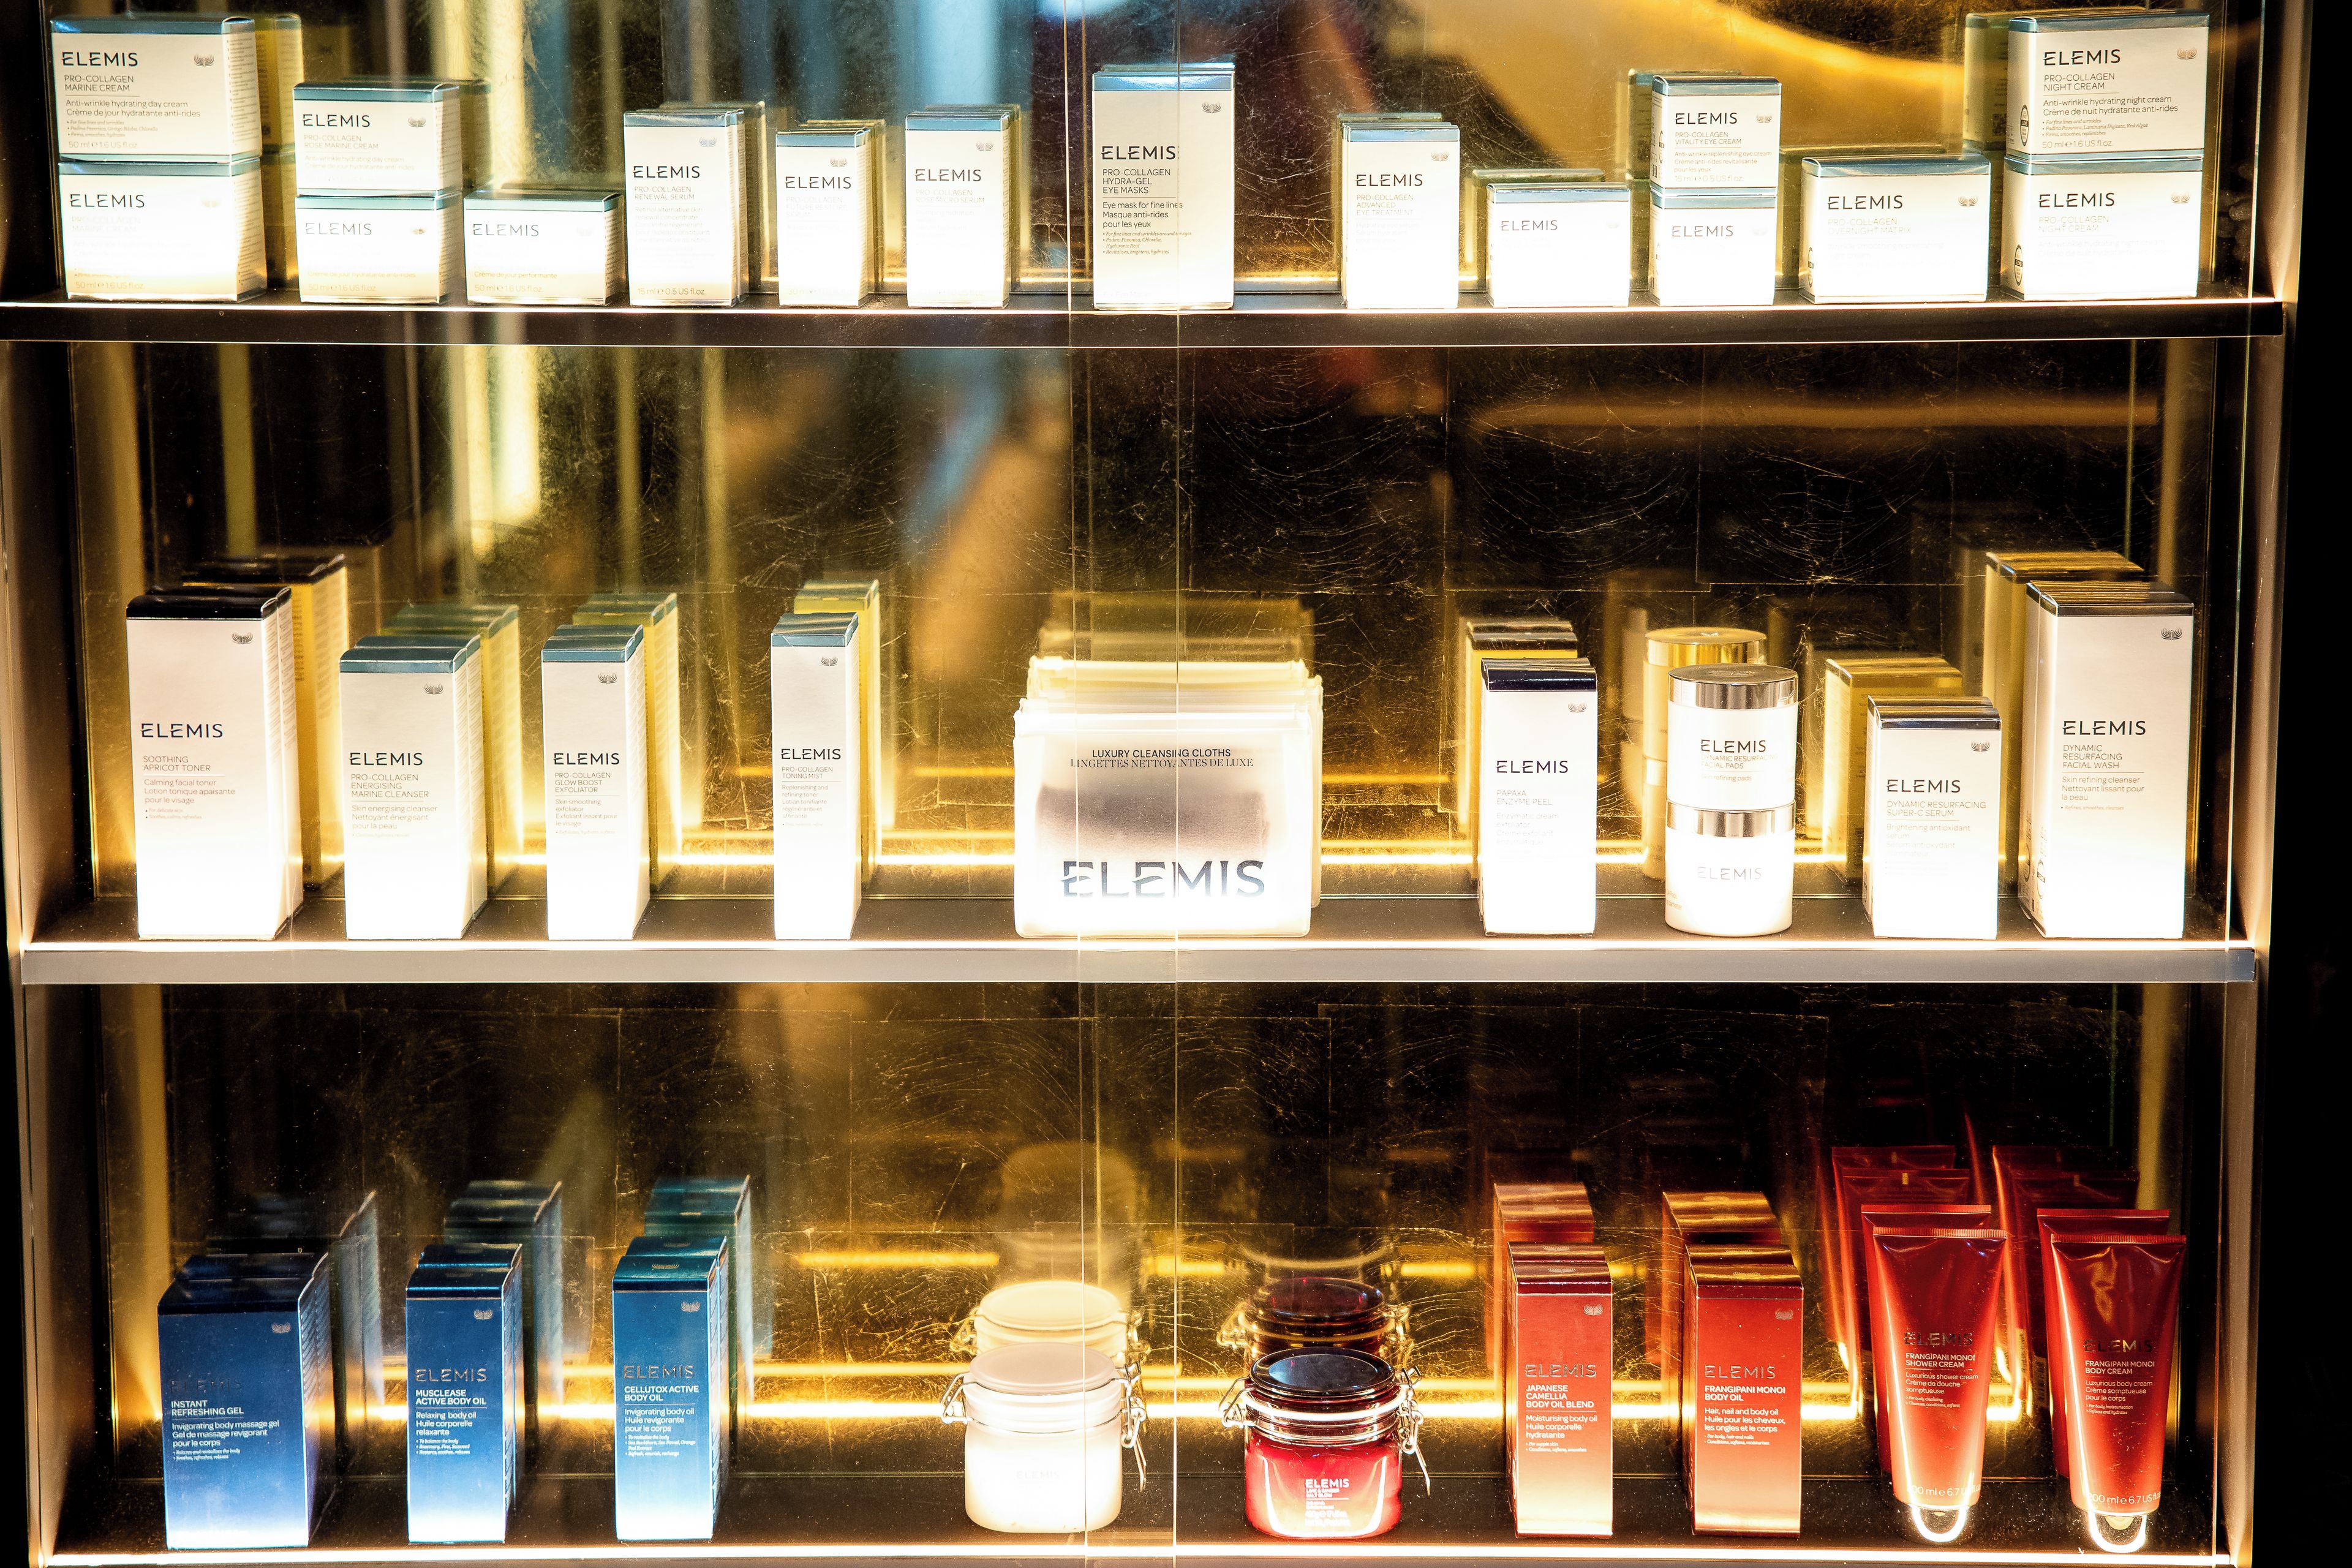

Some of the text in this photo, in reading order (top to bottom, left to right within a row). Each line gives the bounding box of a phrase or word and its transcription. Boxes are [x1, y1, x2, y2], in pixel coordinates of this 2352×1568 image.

[61, 51, 138, 66] ELEMIS
[2043, 49, 2121, 66] ELEMIS
[64, 75, 134, 83] PRO-COLLAGEN
[2044, 73, 2114, 82] PRO-COLLAGEN
[2043, 98, 2088, 107] Anti-wrinkle
[2090, 97, 2125, 106] hydrating
[2127, 97, 2146, 105] night
[2043, 107, 2070, 116] Crème
[2098, 107, 2140, 115] hydratante
[303, 114, 371, 127] ELEMIS
[1675, 113, 1737, 124] ELEMIS
[1101, 146, 1176, 160] ELEMIS
[633, 166, 700, 178] ELEMIS
[914, 168, 981, 181] ELEMIS
[785, 176, 851, 189] ELEMIS
[1355, 174, 1423, 186] ELEMIS
[70, 194, 145, 208] ELEMIS
[1828, 195, 1902, 209] ELEMIS
[2038, 193, 2114, 208] ELEMIS
[306, 222, 372, 235] ELEMIS
[473, 224, 539, 236] ELEMIS
[1501, 220, 1558, 231] ELEMIS
[1672, 225, 1733, 237] ELEMIS
[141, 723, 223, 738] ELEMIS
[2062, 721, 2146, 735] ELEMIS
[1701, 739, 1766, 753] ELEMIS
[349, 753, 423, 766] ELEMIS
[553, 753, 620, 764] ELEMIS
[781, 748, 841, 760] ELEMIS
[1133, 749, 1189, 758] CLEANSING
[1071, 759, 1129, 768] LINGETTES
[1131, 759, 1207, 768] NETTOYANTES
[1496, 761, 1568, 773] ELEMIS
[1887, 780, 1960, 793] ELEMIS
[1060, 861, 1264, 897] ELEMIS
[1697, 867, 1762, 880] ELEMIS
[1903, 1332, 1973, 1346] ELEMIS
[2083, 1340, 2154, 1352] ELEMIS
[415, 1368, 488, 1382] ELEMIS
[623, 1365, 694, 1379] ELEMIS
[1525, 1364, 1596, 1377] ELEMIS
[1705, 1365, 1776, 1379] ELEMIS
[1305, 1479, 1349, 1488] ELEMIS
